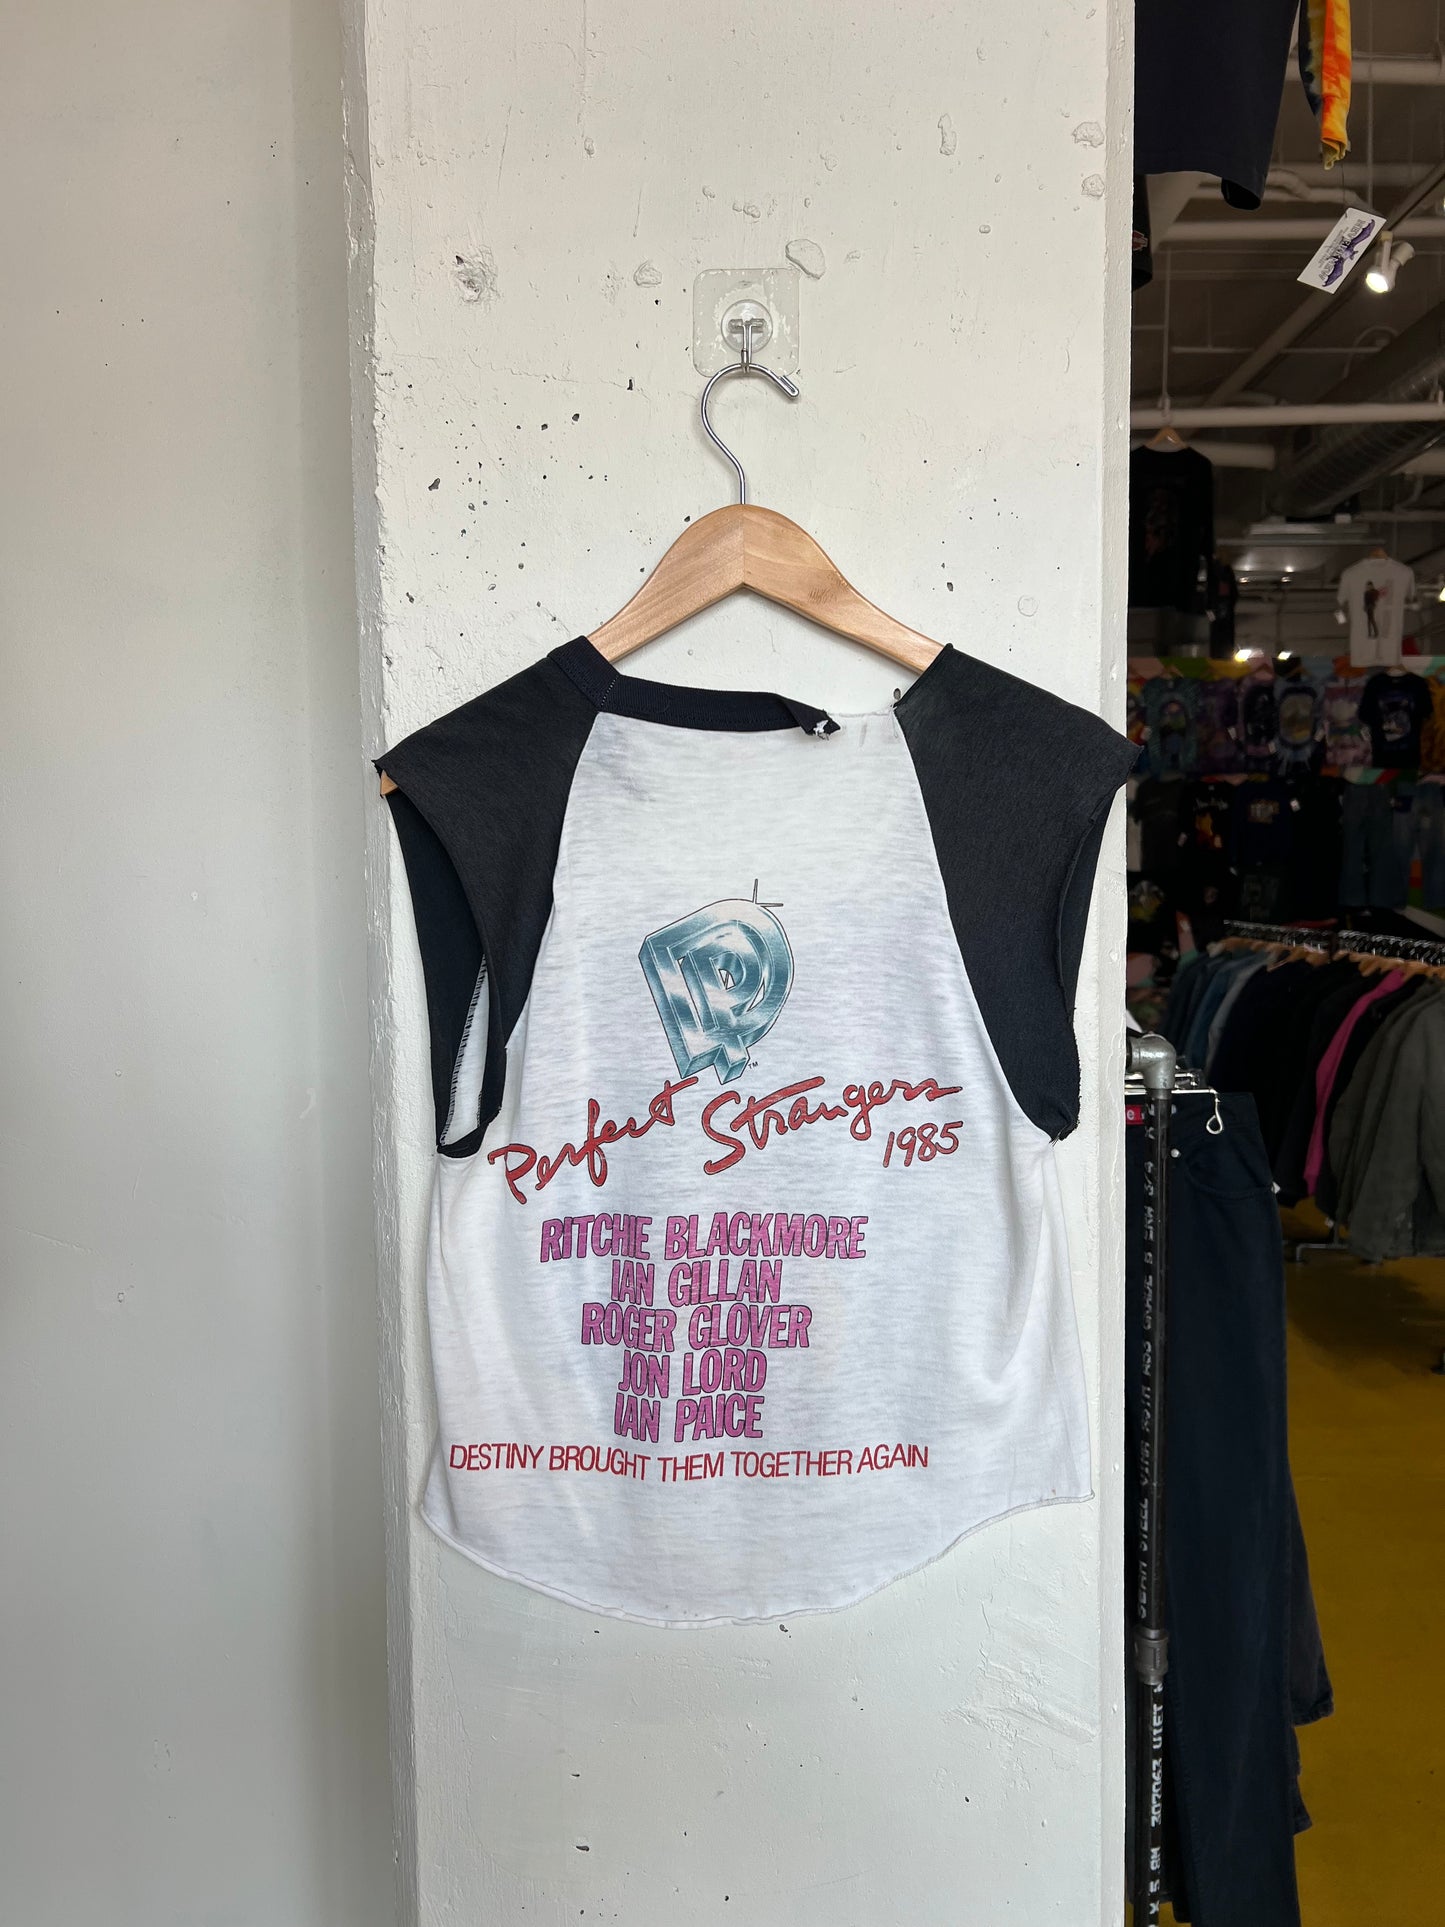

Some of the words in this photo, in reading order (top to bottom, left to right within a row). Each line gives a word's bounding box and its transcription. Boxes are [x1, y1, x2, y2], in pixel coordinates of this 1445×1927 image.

[488, 1076, 699, 1204] Perfect
[702, 1076, 963, 1175] Strangers
[883, 1120, 964, 1168] 1985
[540, 1213, 652, 1263] RITCHIE
[664, 1212, 869, 1260] BLACKMORE
[611, 1259, 654, 1304] IAN
[667, 1258, 783, 1305] GILLAN
[581, 1302, 677, 1352] ROGER
[688, 1303, 812, 1349] GLOVER
[618, 1350, 670, 1398] JON
[682, 1349, 767, 1394] LORD
[614, 1394, 660, 1443] IAN
[674, 1394, 765, 1442] PAICE
[450, 1443, 545, 1471] DESTINY
[549, 1445, 650, 1481] BROUGHT
[658, 1452, 725, 1482] THEM
[731, 1450, 853, 1478] TOGETHER
[857, 1443, 929, 1473] AGAIN
